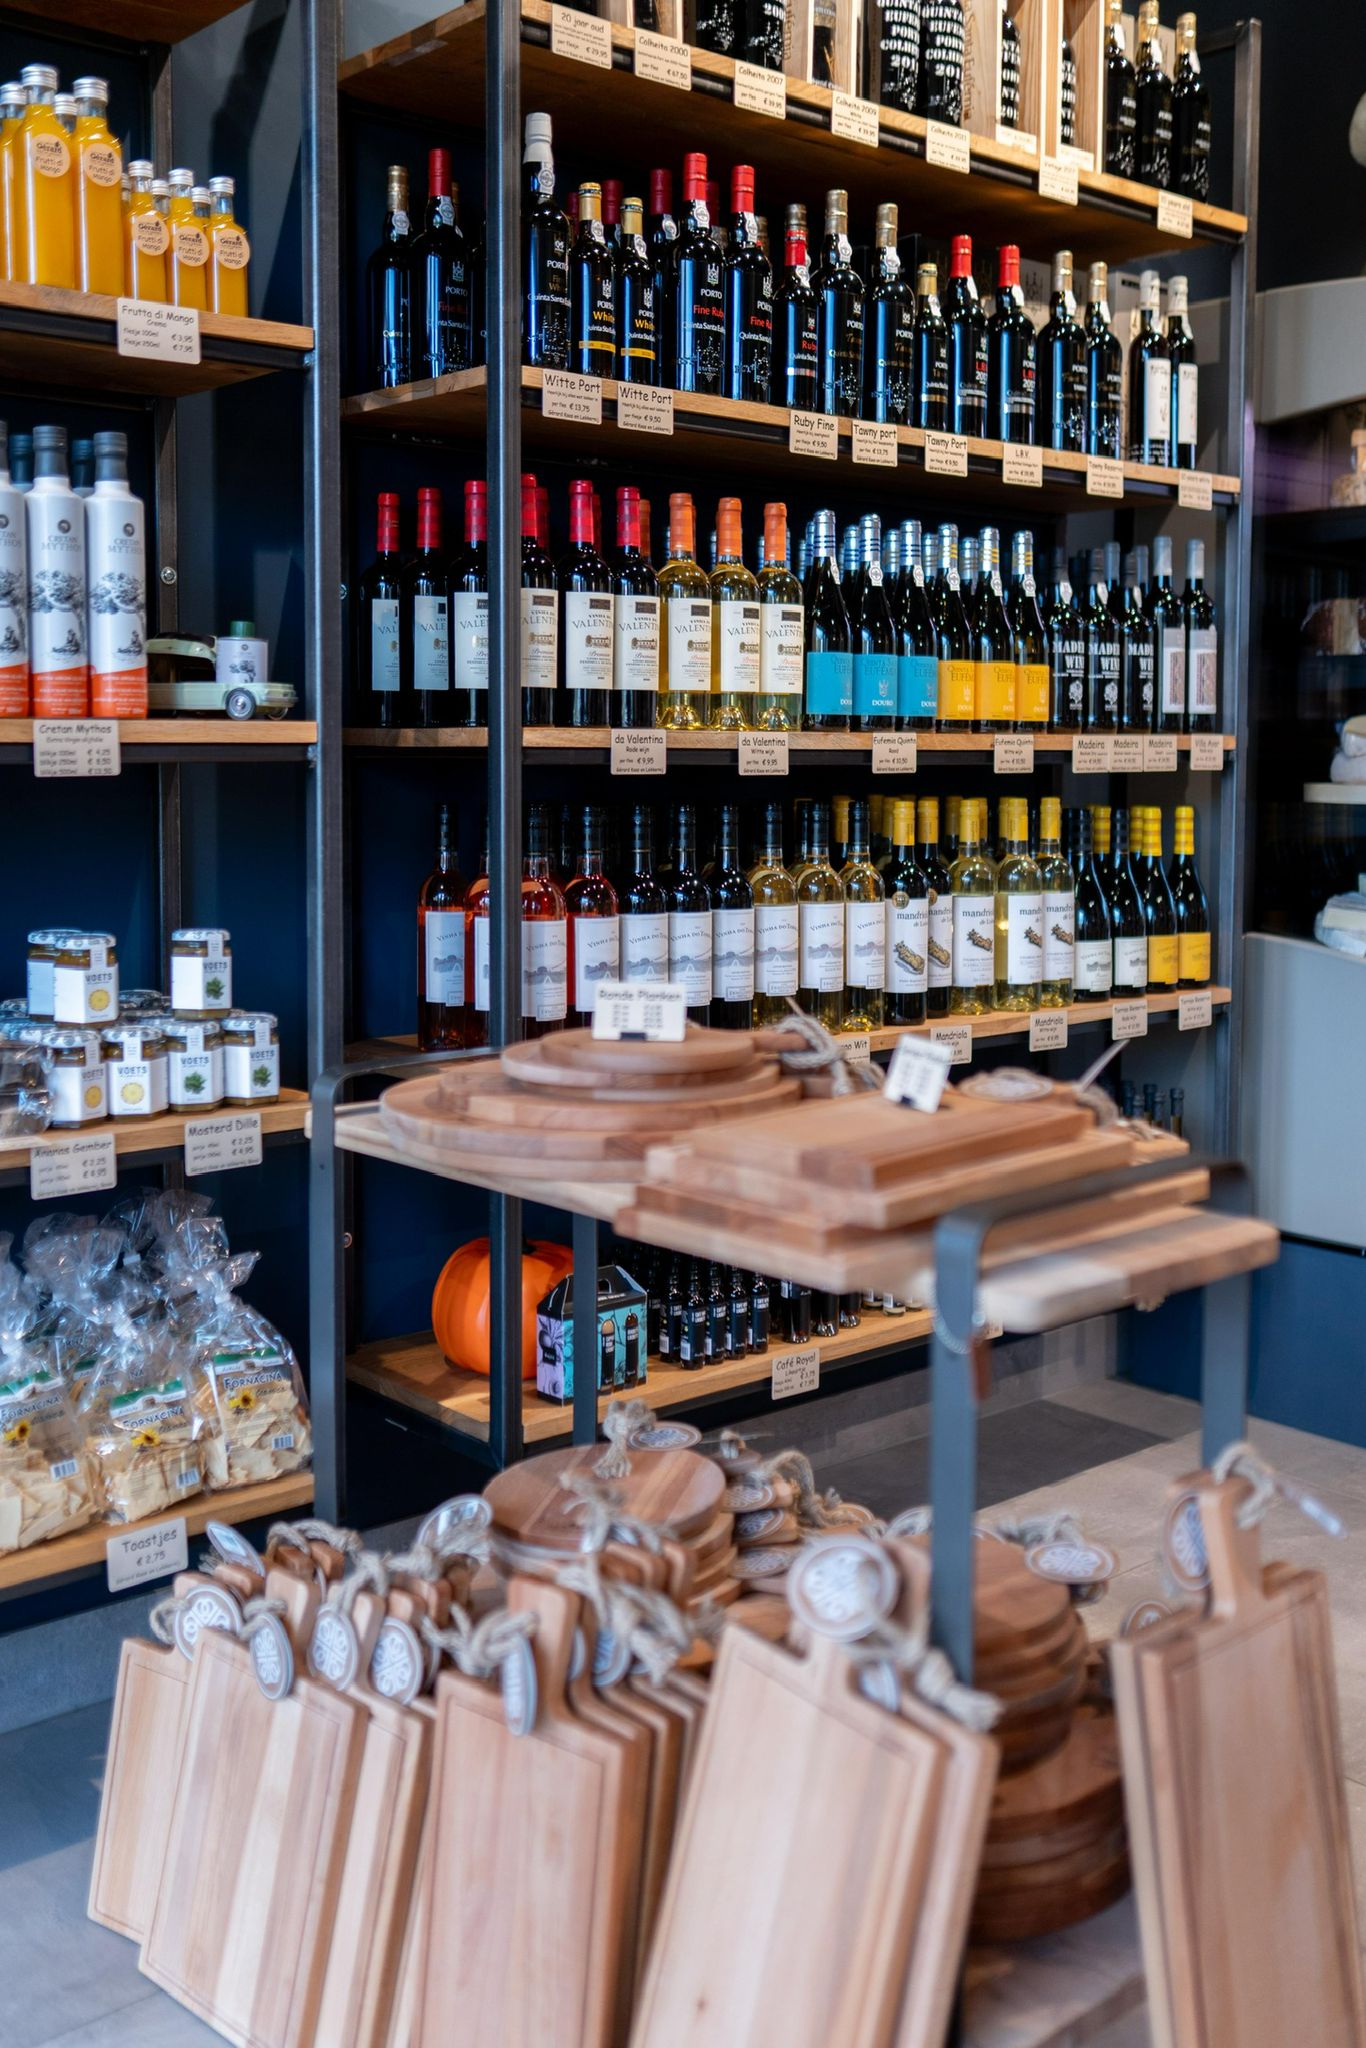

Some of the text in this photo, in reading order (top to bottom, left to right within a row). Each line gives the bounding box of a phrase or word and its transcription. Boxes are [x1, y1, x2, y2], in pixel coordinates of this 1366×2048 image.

[561, 12, 605, 34] 20 jaar oud
[639, 36, 689, 58] Colheita 2000
[738, 66, 784, 86] Colheita 2007
[835, 95, 861, 111] Colheita
[700, 287, 723, 300] PORTO
[693, 304, 710, 315] Fine
[155, 311, 163, 319] di
[166, 312, 194, 326] Mango
[750, 316, 765, 327] Fine
[544, 373, 600, 394] Witte Port
[620, 386, 673, 405] Witte Port
[574, 403, 590, 413] 13,75
[649, 415, 662, 424] 9,50
[794, 415, 835, 431] Ruby Fine
[854, 424, 897, 440] Tawny port
[817, 440, 828, 449] 9,50
[926, 435, 967, 450] Tawny Port
[39, 724, 112, 735] Cretan Mythos
[615, 734, 664, 744] da Valentina
[741, 736, 786, 747] da Valentina
[1113, 739, 1139, 749] Madeira
[1149, 739, 1173, 749] Madeira
[1078, 740, 1105, 750] Madeira
[639, 747, 650, 755] wijn
[765, 749, 775, 757] wijn
[642, 757, 654, 765] 9,95
[203, 961, 228, 971] VOETS
[85, 972, 113, 983] VOETS
[1034, 1016, 1064, 1028] Mandriola
[935, 1029, 968, 1041] Mandriola
[250, 1049, 276, 1059] VOETS
[180, 1056, 210, 1065] VOETS
[117, 1066, 148, 1075] VOETS
[188, 1117, 259, 1138] Mosterd Dille
[72, 1140, 113, 1152] Gember
[776, 1351, 816, 1371] Café Royal
[223, 1370, 283, 1390] FORNACINA
[121, 1529, 177, 1553] Toastjes
[136, 1550, 166, 1567] € 2,75
